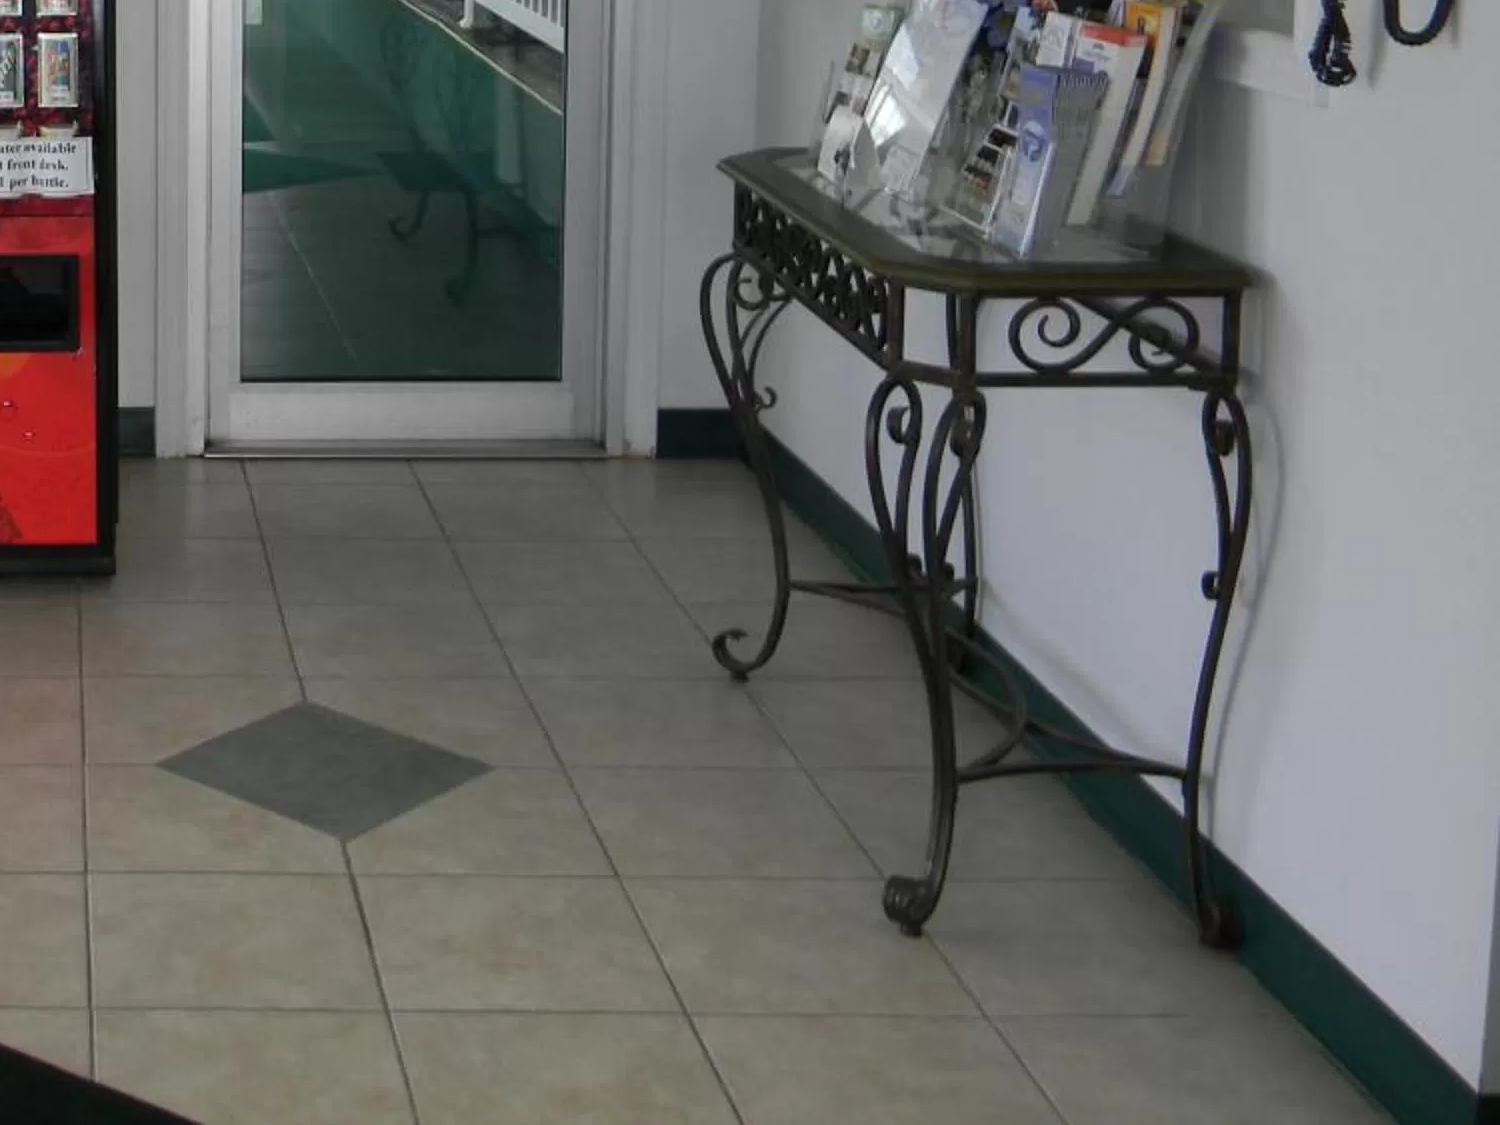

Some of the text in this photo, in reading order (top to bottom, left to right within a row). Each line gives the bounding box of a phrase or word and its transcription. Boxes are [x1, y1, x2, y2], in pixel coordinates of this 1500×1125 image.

[23, 142, 77, 154] available
[7, 159, 35, 170] front
[9, 177, 29, 192] per
